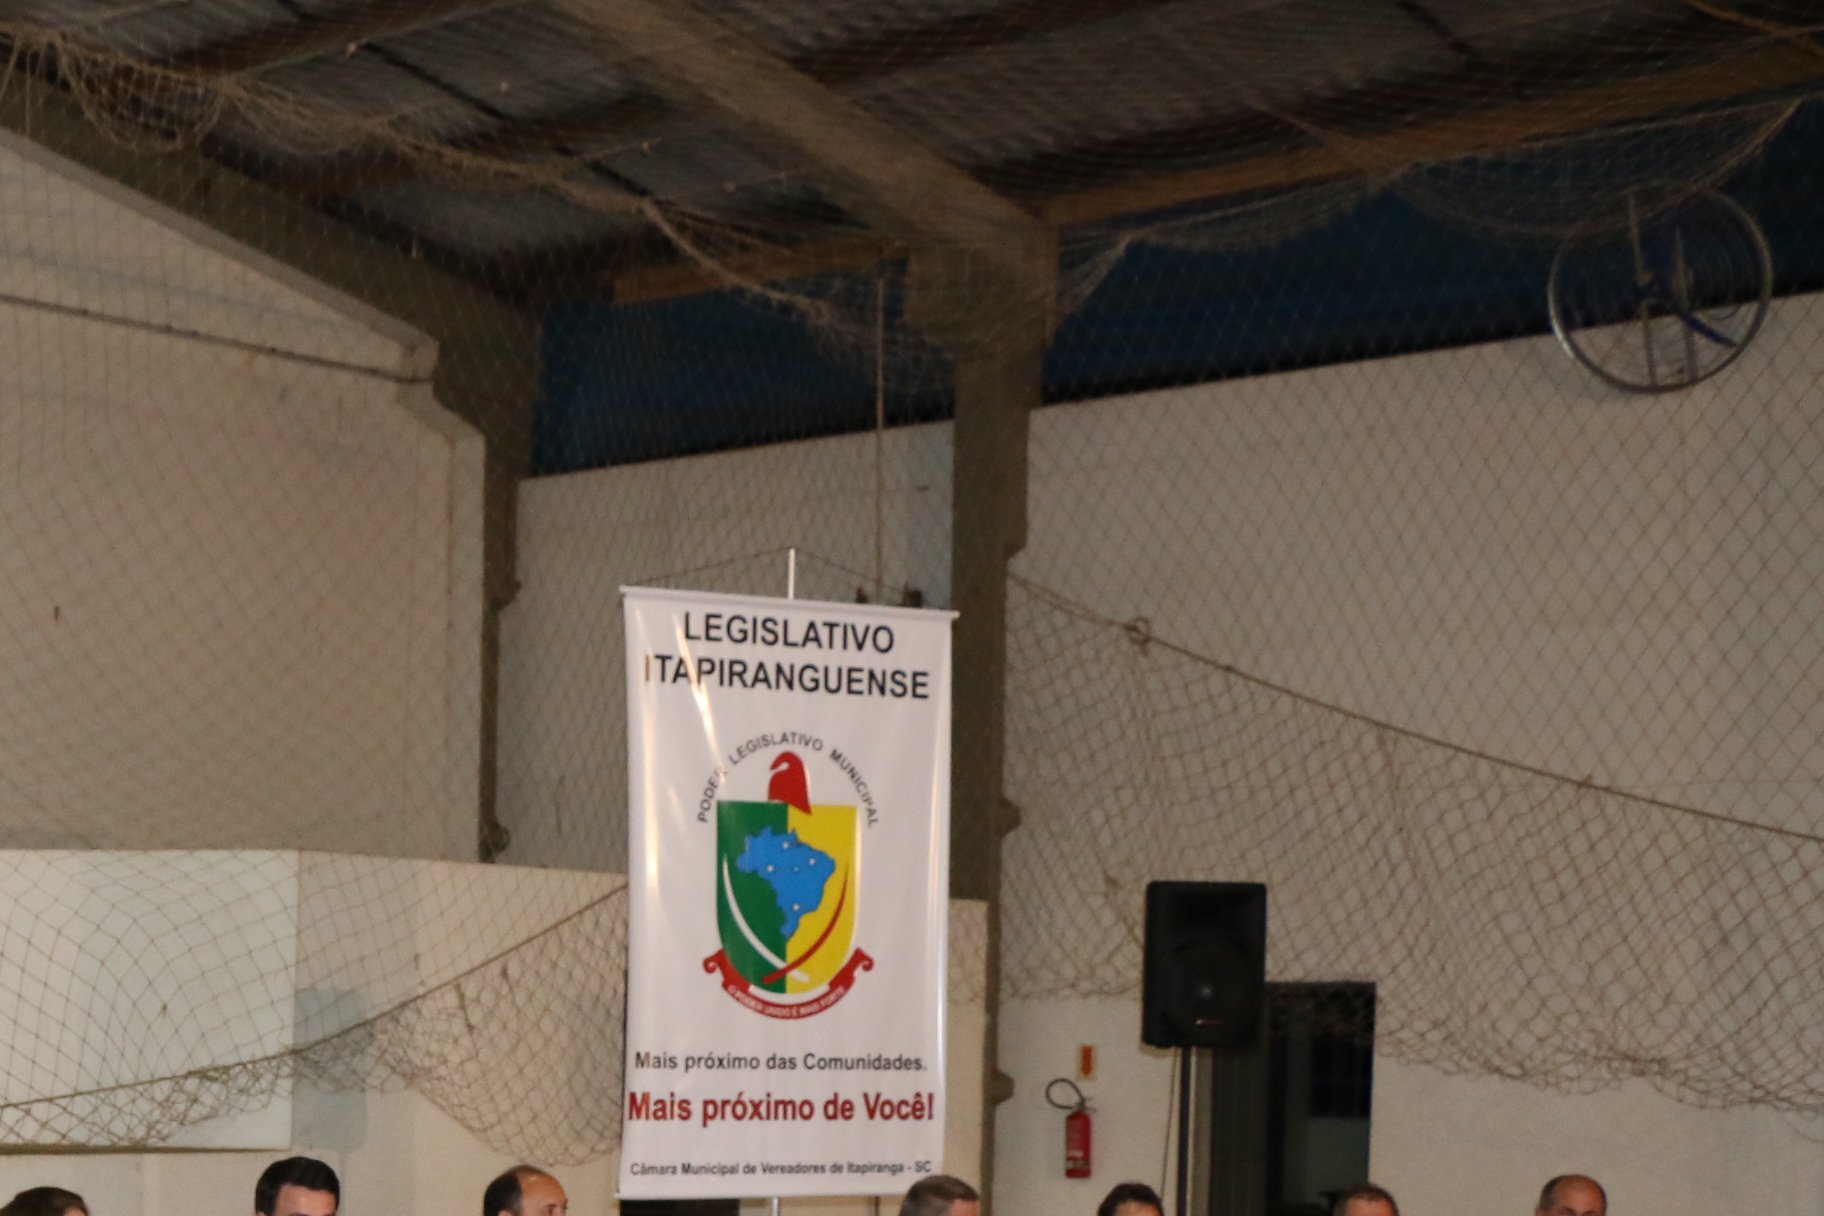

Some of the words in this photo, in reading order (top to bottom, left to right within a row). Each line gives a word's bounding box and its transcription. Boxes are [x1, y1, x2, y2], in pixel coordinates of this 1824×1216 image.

[684, 611, 895, 653] LEGISLATIVO
[645, 653, 930, 699] ITAPIRANGUENSE
[728, 731, 825, 766] LEGISLATIVO
[829, 749, 880, 829] MUNICIPAL
[634, 1051, 678, 1070] Mais
[684, 1051, 760, 1074] próximo
[766, 1051, 797, 1070] das
[803, 1053, 928, 1071] Comunidades.
[628, 1091, 692, 1121] Mais
[702, 1091, 815, 1128] próximo
[823, 1092, 855, 1121] de
[863, 1091, 935, 1121] Você!
[630, 1161, 677, 1176] Câmara
[681, 1161, 739, 1178] Municipal
[742, 1161, 757, 1175] de
[760, 1161, 827, 1175] Vereadores
[829, 1160, 844, 1174] de
[847, 1160, 905, 1176] Itapiranga
[915, 1160, 932, 1174] SC
